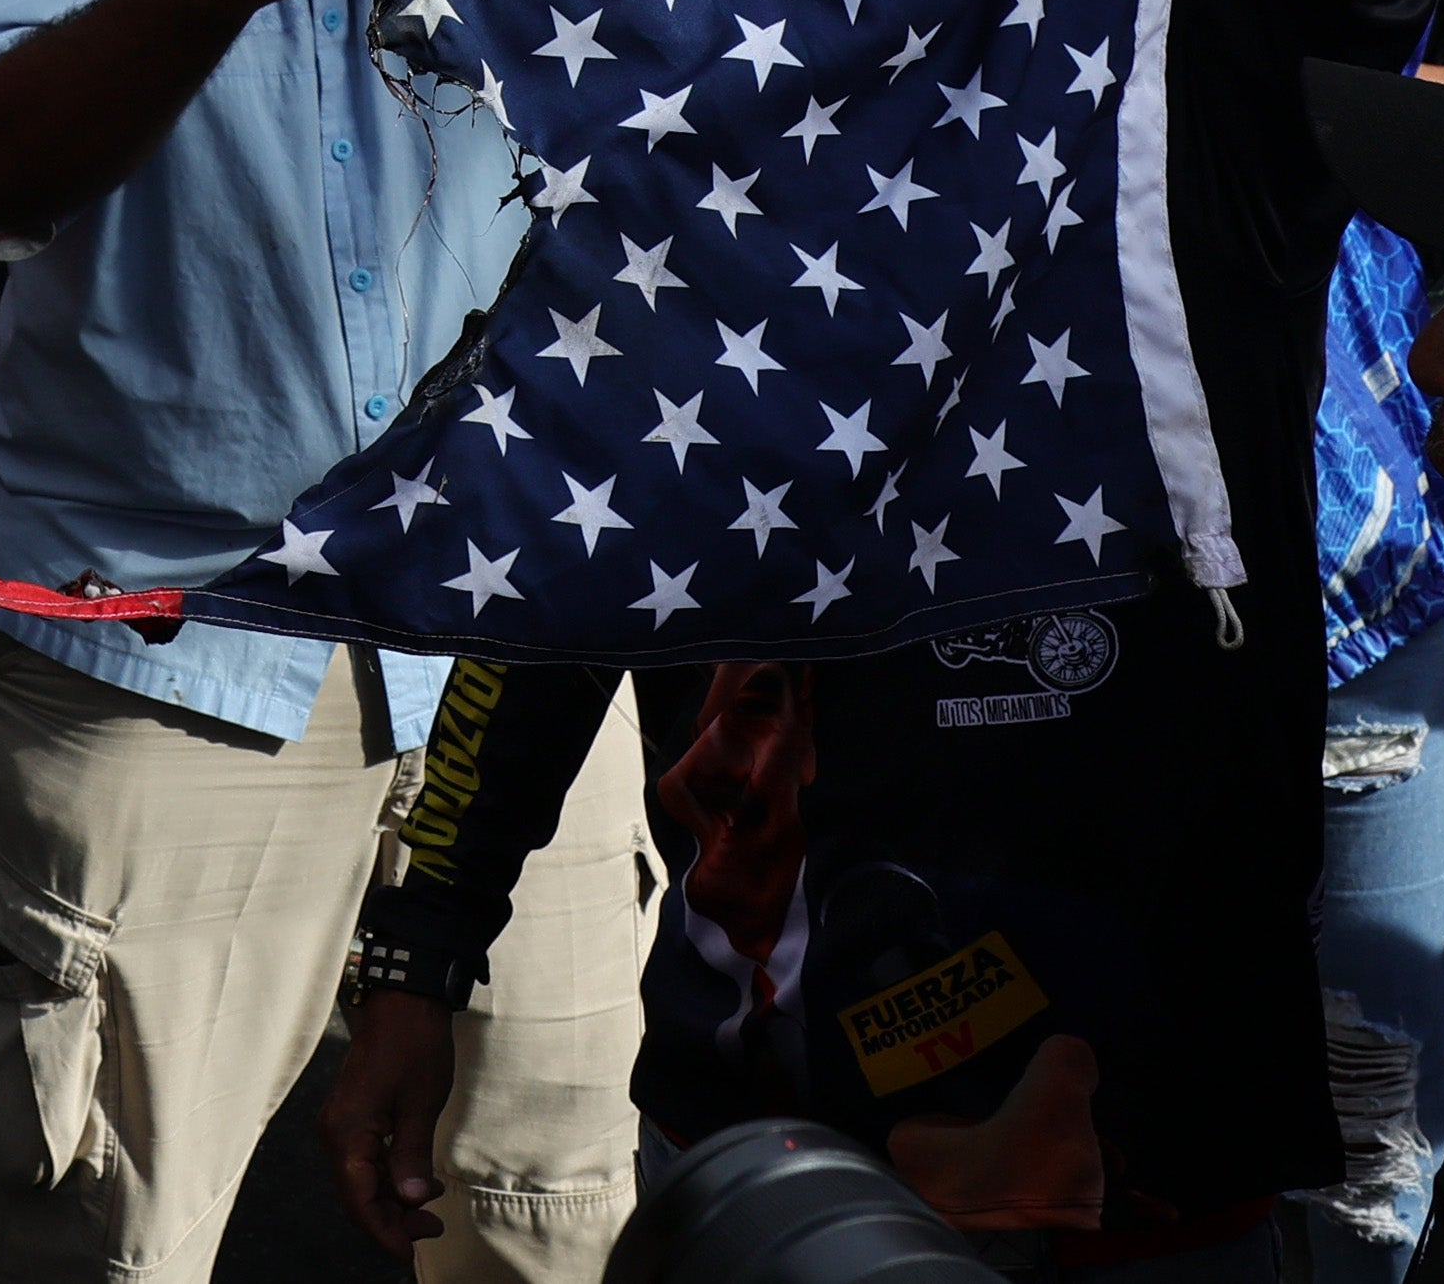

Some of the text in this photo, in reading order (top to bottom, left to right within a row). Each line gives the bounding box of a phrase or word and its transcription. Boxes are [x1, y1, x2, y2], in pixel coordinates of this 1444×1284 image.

[850, 946, 1007, 1040] FUERZA
[861, 967, 1015, 1057] MOTORIZADA
[913, 1019, 976, 1073] TV
